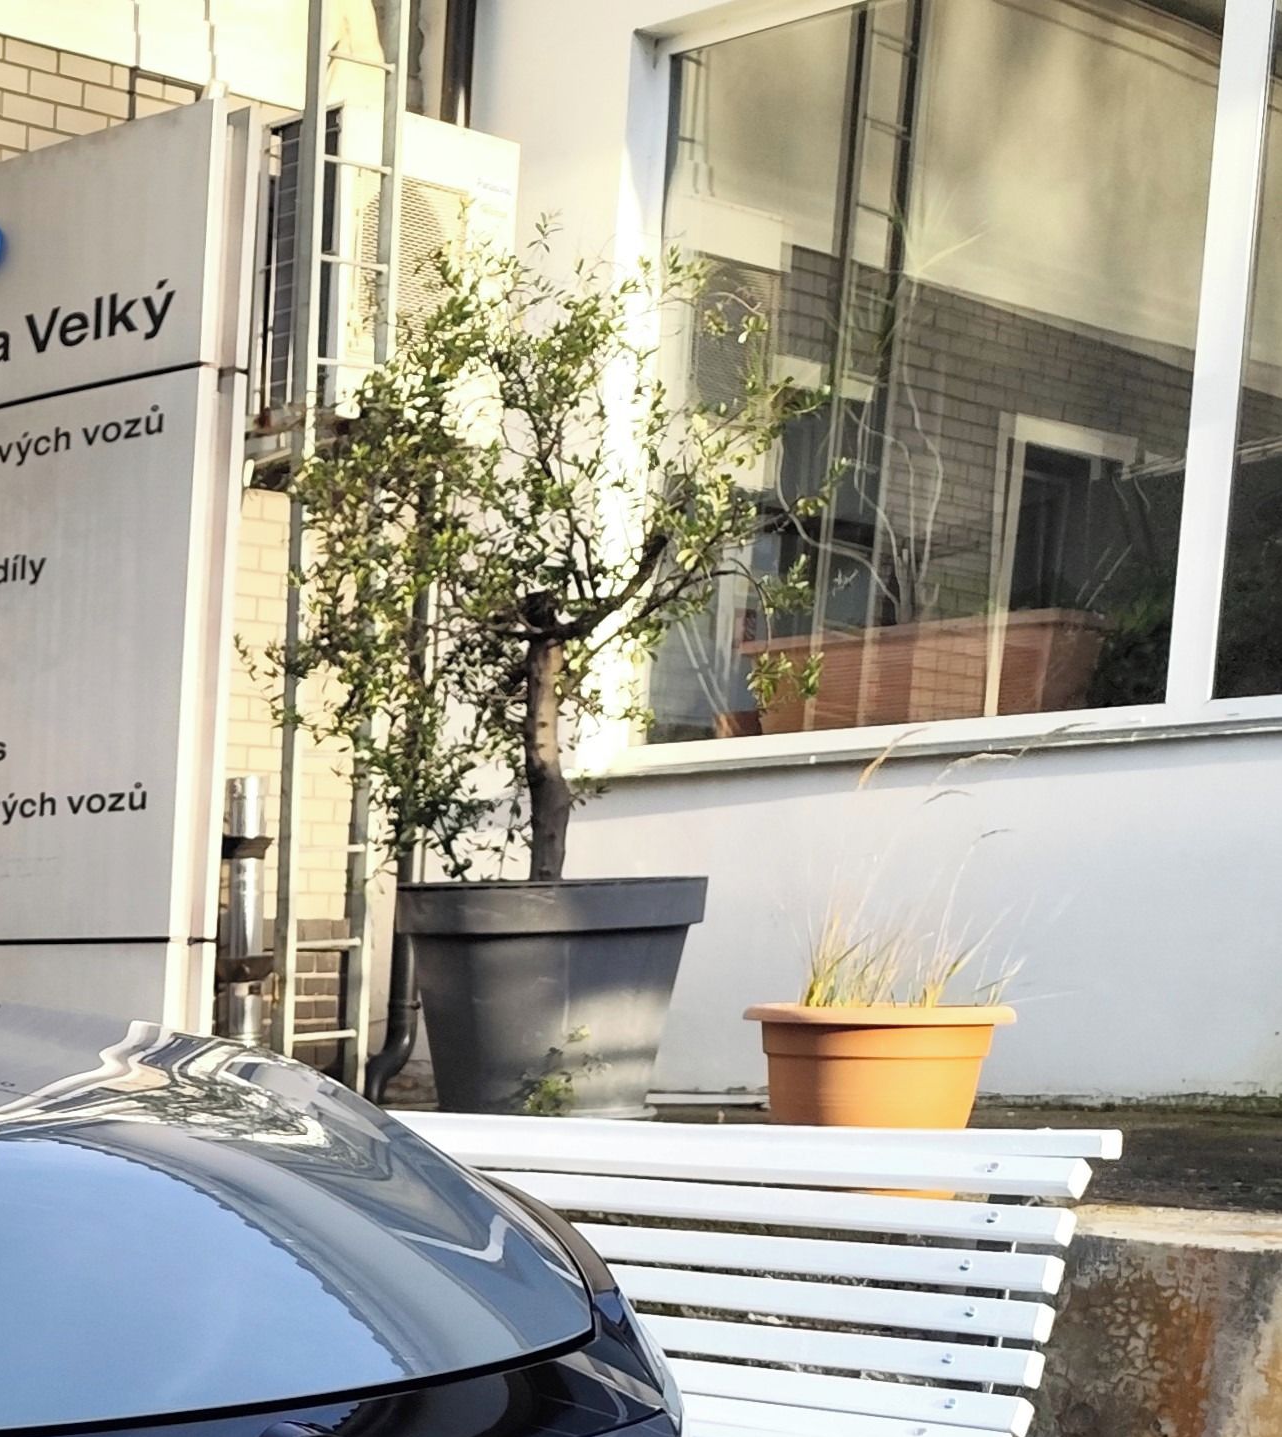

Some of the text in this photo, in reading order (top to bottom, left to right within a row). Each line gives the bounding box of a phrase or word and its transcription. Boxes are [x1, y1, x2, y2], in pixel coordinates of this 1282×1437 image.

[25, 279, 176, 353] Velký
[82, 404, 165, 446] vozů
[67, 782, 147, 814] vozů
